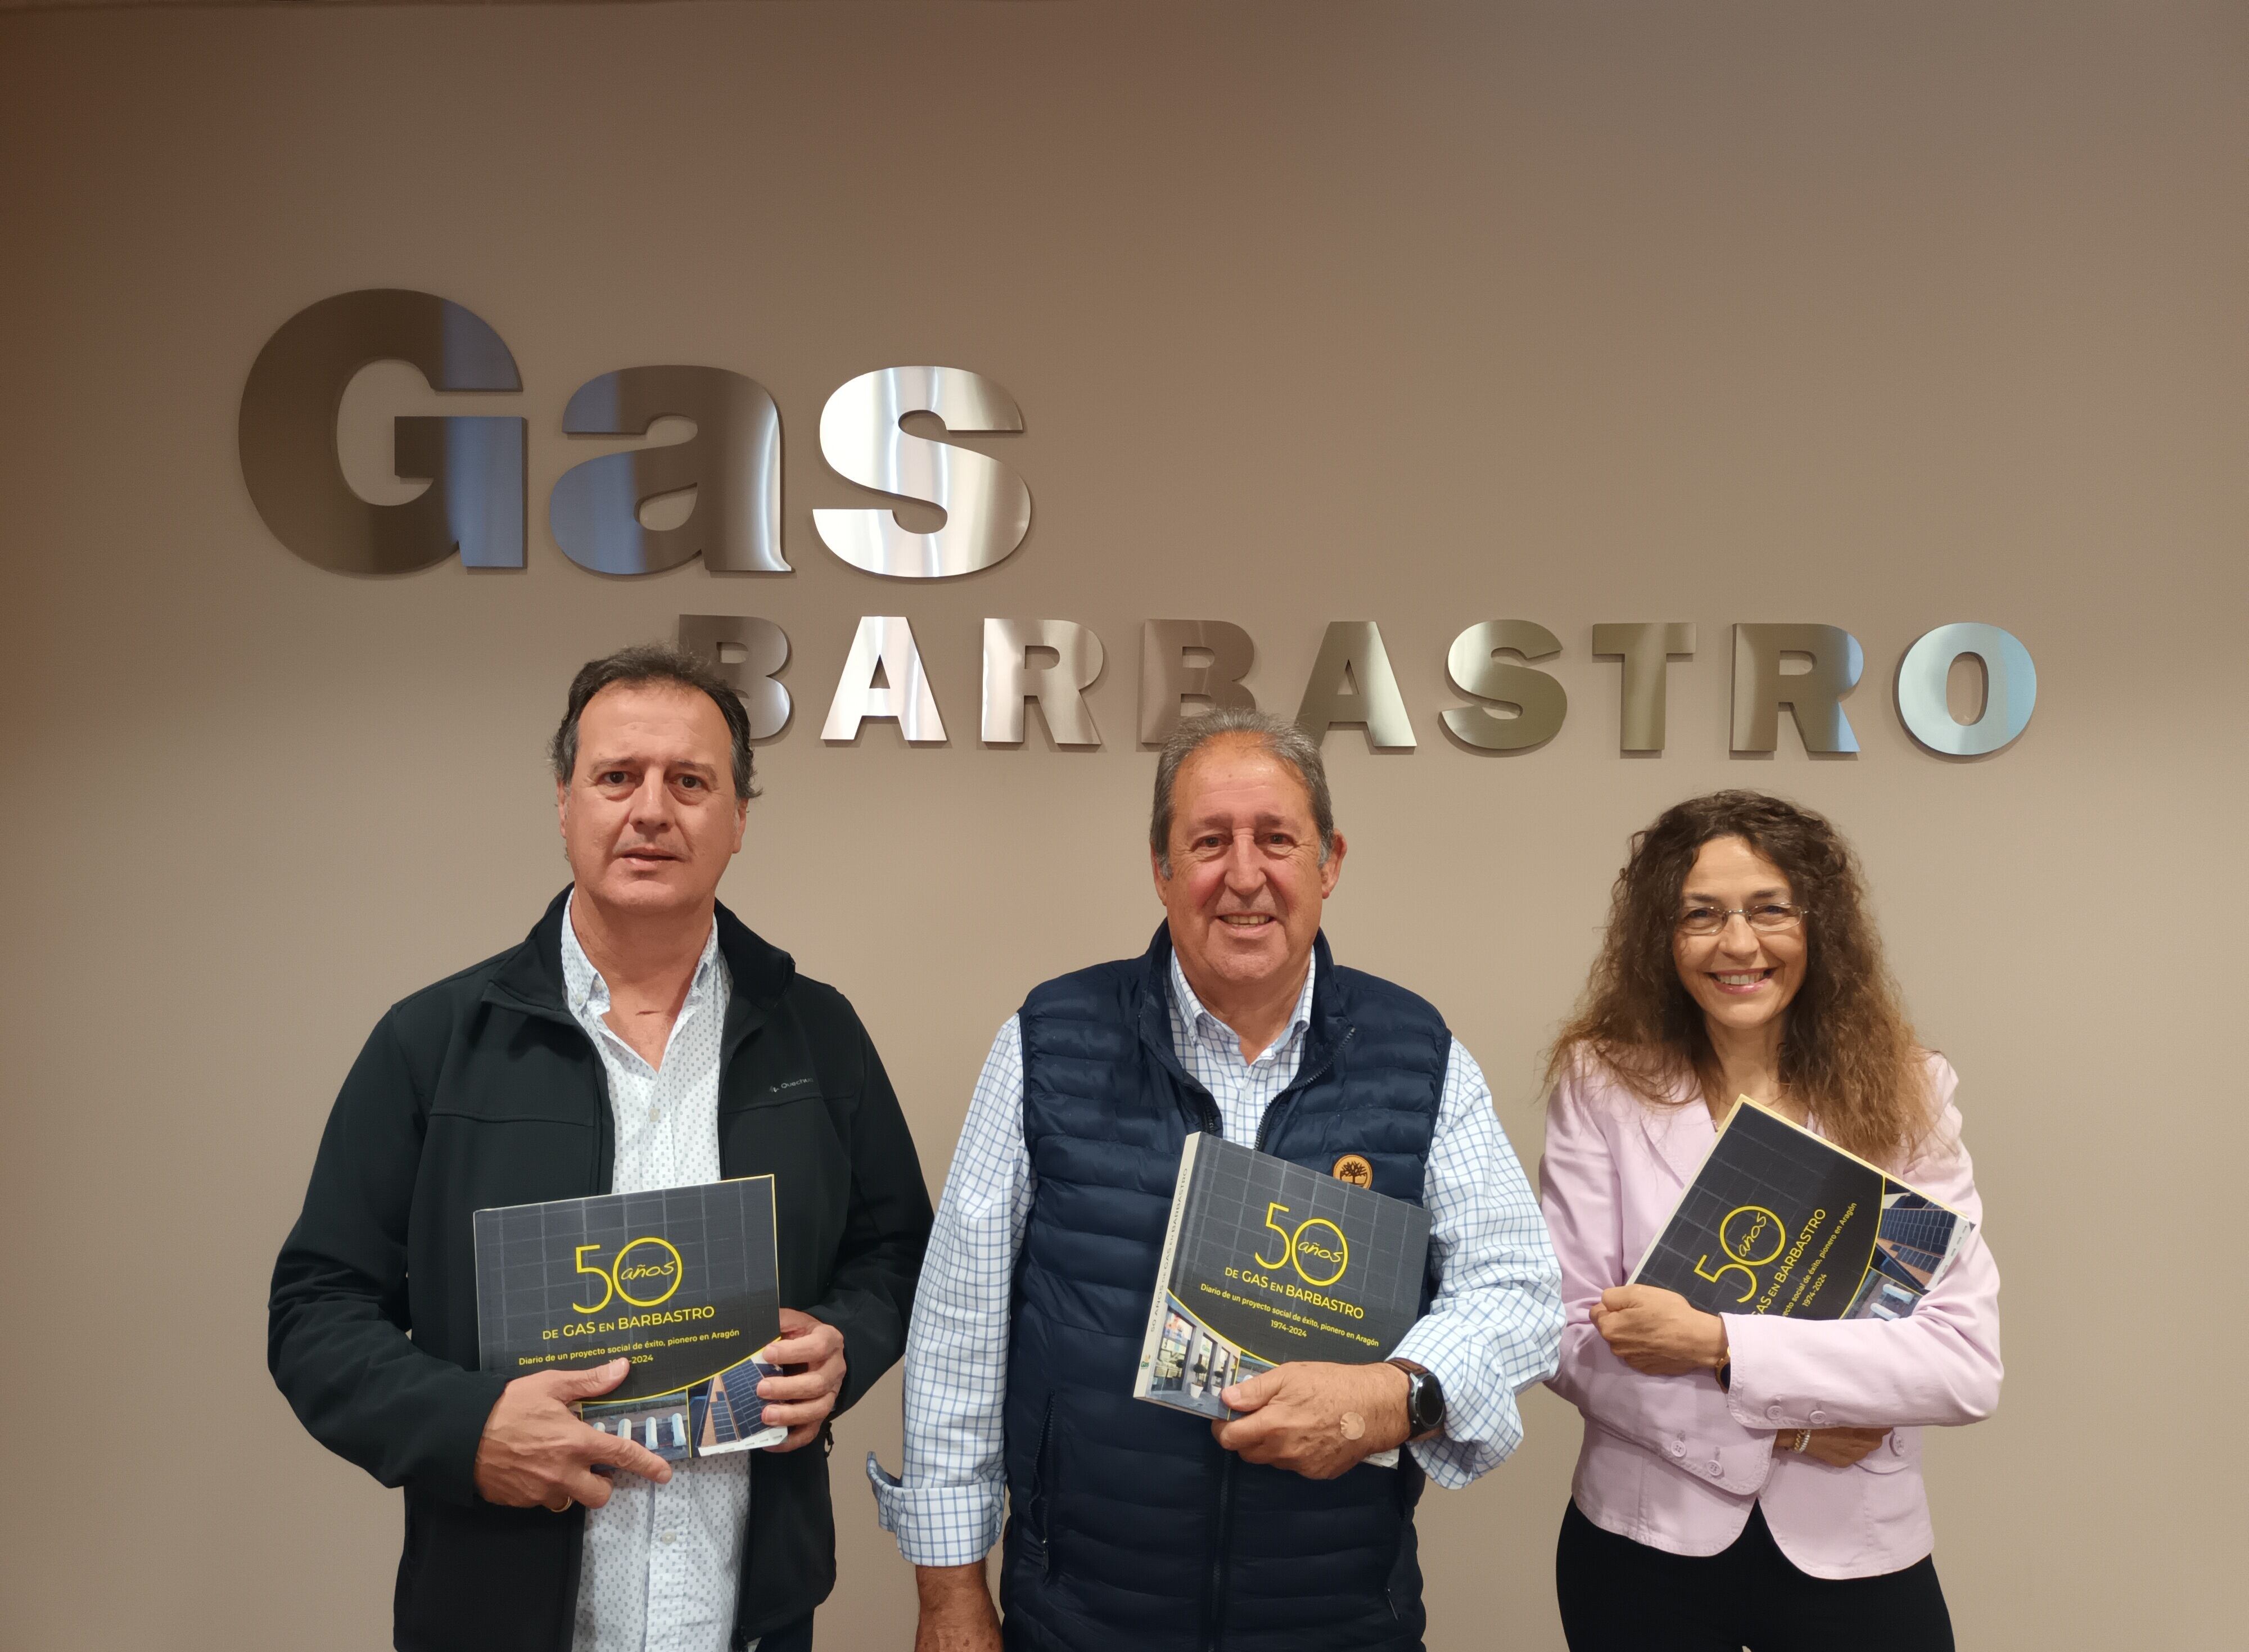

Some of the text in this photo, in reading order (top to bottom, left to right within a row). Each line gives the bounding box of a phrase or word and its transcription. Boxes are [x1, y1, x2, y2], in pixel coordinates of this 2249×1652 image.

[238, 288, 1032, 577] Gas
[678, 615, 2036, 755] BARBASTRO
[780, 1077, 814, 1089] Quechua
[1254, 1202, 1348, 1287] 50 años
[1693, 1205, 1786, 1303] 50 años
[1774, 1209, 1826, 1283] BARBASTRO
[1792, 1283, 1805, 1302] social
[1803, 1274, 1812, 1284] de
[1808, 1259, 1823, 1275] éxito,
[1819, 1234, 1837, 1259] pionero
[1835, 1225, 1842, 1234] en
[1839, 1202, 1858, 1226] Aragón
[572, 1236, 682, 1314] 50 años
[1225, 1267, 1364, 1320] DE GAS EN BARBASTRO
[1768, 1283, 1781, 1297] EN
[1802, 1273, 1827, 1307] 1974-2024
[543, 1306, 715, 1340] DE GAS EN BARBASTRO
[1200, 1283, 1221, 1296] Diario
[1222, 1290, 1231, 1299] de
[1241, 1298, 1271, 1312] proyecto
[1272, 1307, 1291, 1319] social
[1292, 1313, 1301, 1321] de
[1302, 1316, 1320, 1328] éxito,
[1320, 1323, 1345, 1336] pionero
[1355, 1334, 1379, 1347] Aragón
[1271, 1319, 1307, 1338] 1974-2024
[518, 1356, 543, 1365] Diario
[570, 1347, 606, 1360] proyecto
[607, 1343, 631, 1353] social
[633, 1342, 643, 1351] de
[644, 1339, 666, 1348] éxito,
[667, 1336, 698, 1347] pionero
[711, 1329, 740, 1339] Aragón
[608, 1354, 653, 1364] -2024
